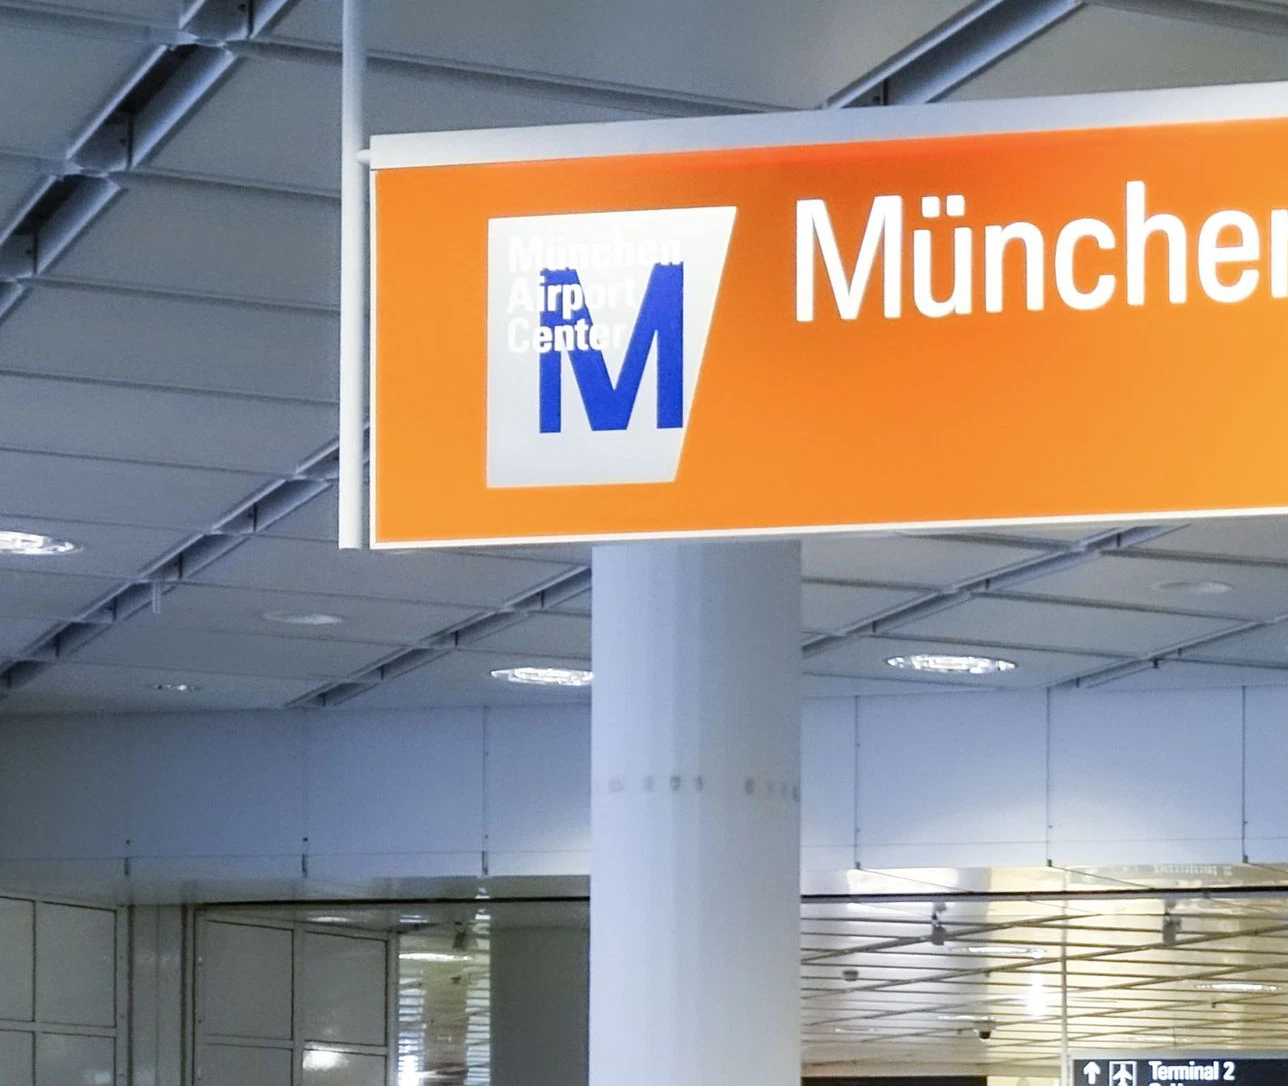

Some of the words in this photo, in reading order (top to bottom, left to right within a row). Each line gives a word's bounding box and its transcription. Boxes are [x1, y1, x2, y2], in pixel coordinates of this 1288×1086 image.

[507, 276, 637, 320] Airport
[506, 315, 627, 354] Center
[539, 261, 684, 433] M
[1148, 1061, 1219, 1081] Terminal
[1223, 1061, 1235, 1081] 2
